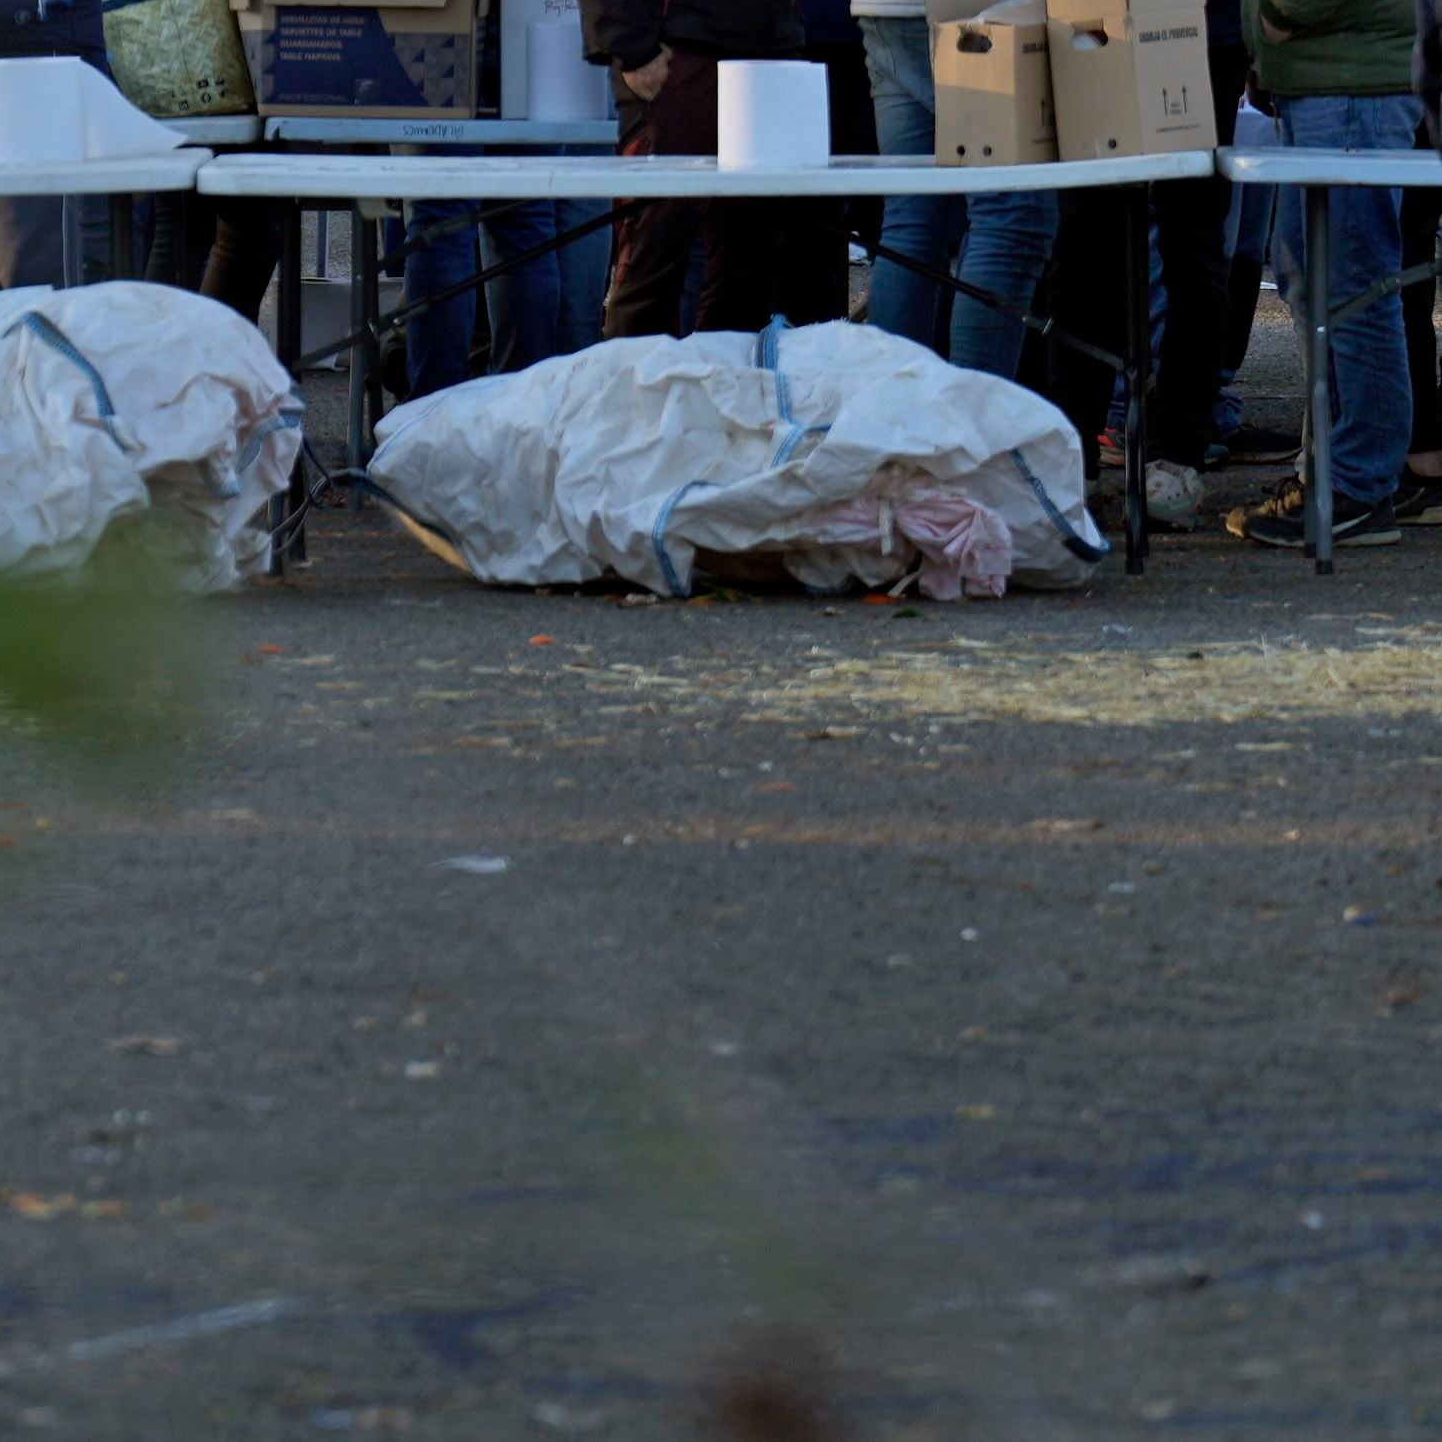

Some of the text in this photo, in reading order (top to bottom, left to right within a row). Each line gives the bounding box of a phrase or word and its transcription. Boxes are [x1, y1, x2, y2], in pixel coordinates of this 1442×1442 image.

[280, 15, 327, 24] SERVILLETAS
[280, 27, 323, 36] SERVIETTES
[339, 28, 362, 37] TABLE
[280, 52, 341, 61] TABLE NAPKINS
